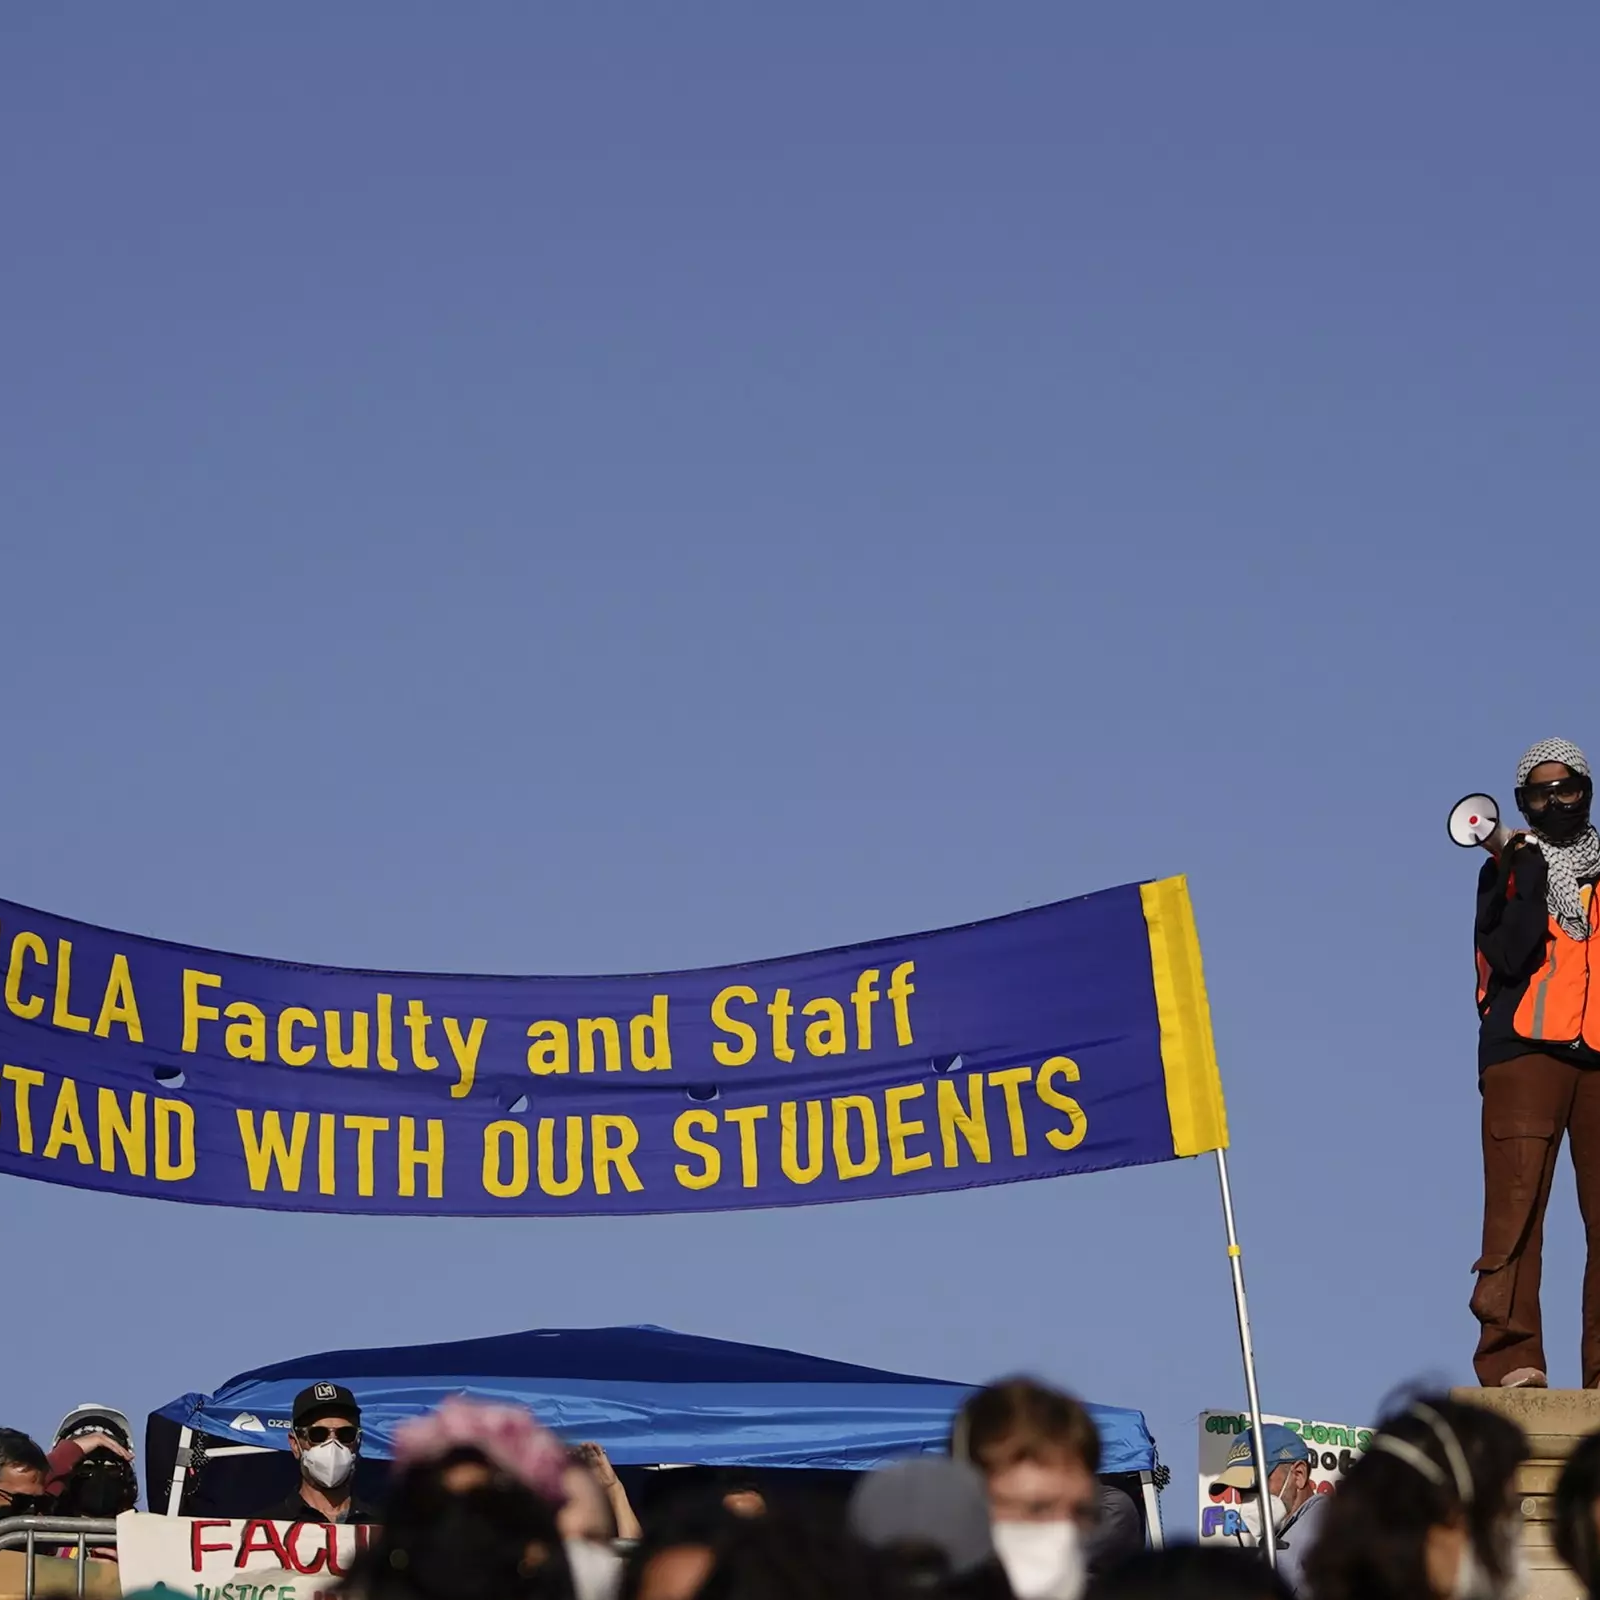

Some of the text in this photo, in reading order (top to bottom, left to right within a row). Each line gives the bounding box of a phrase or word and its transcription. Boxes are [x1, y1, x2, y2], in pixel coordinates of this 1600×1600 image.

[181, 969, 487, 1098] Faculty
[527, 994, 672, 1076] and
[712, 961, 917, 1066] Staff
[237, 1109, 445, 1198] WITH
[482, 1114, 643, 1198] OUR
[673, 1056, 1088, 1190] STUDENTS
[267, 1418, 291, 1428] oza
[191, 1519, 373, 1577] FACU
[1202, 1506, 1249, 1537] FR
